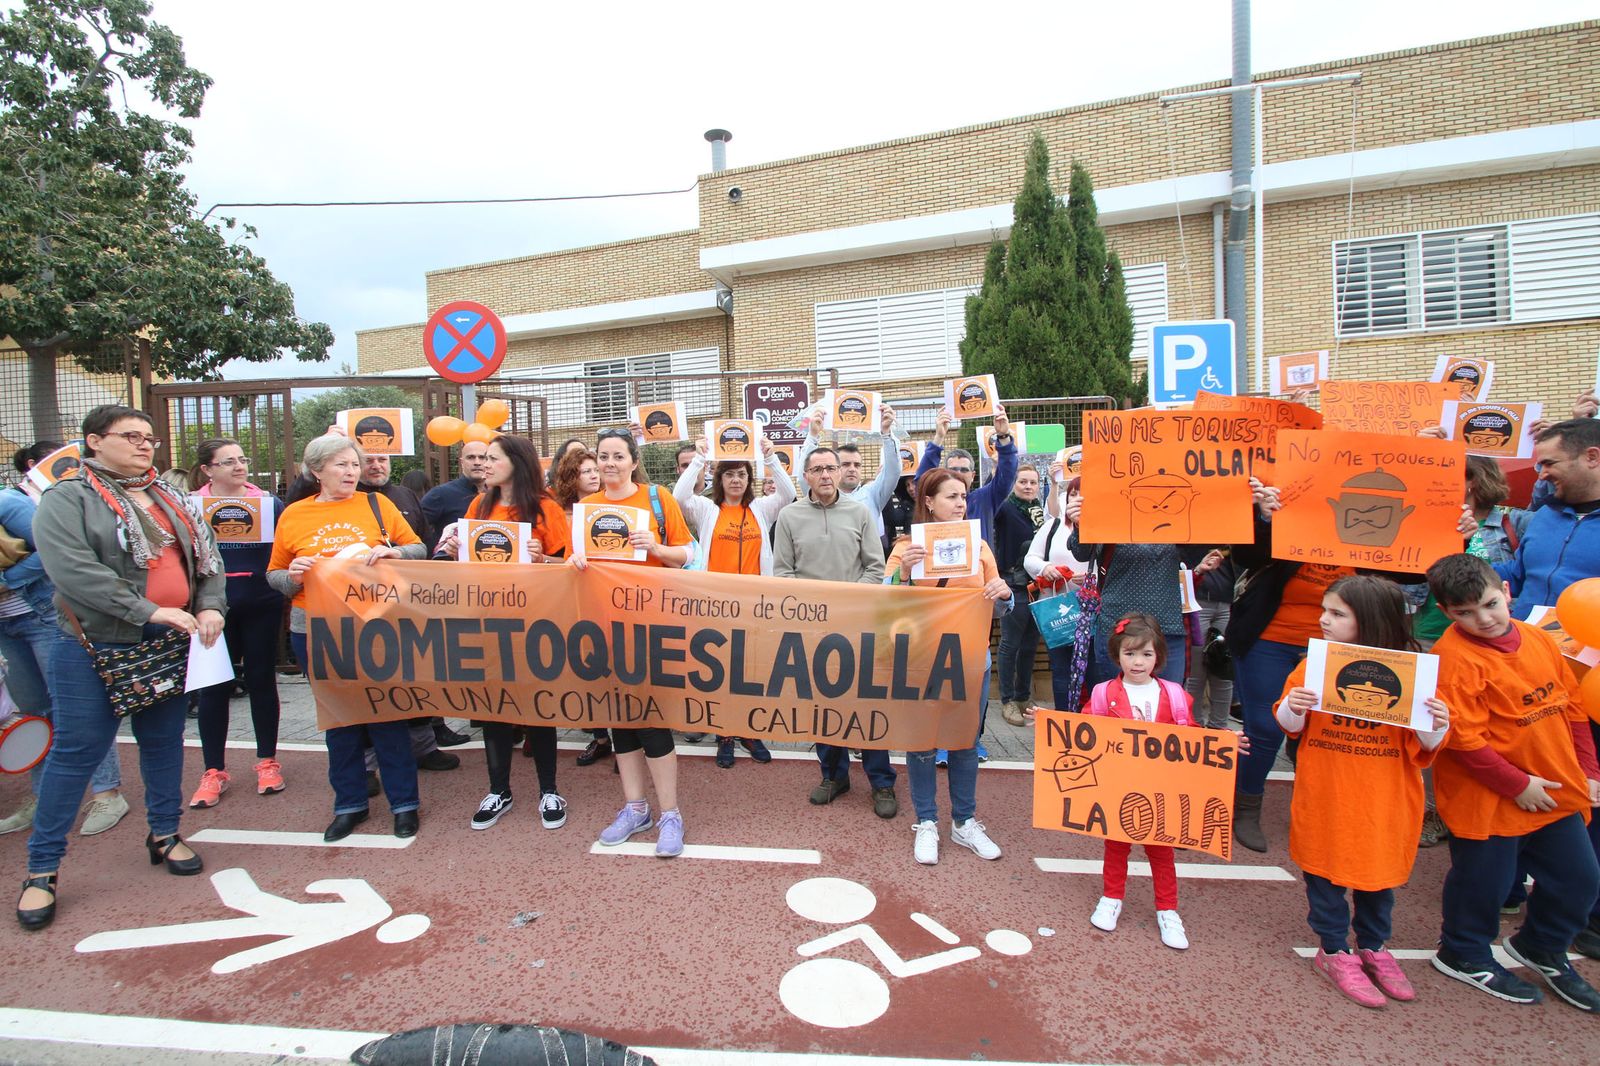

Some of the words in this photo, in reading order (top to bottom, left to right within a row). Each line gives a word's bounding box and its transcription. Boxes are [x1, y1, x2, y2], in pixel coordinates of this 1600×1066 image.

[1163, 335, 1207, 391] P
[1325, 381, 1432, 406] SUSANA
[772, 409, 802, 417] ALARM
[1353, 404, 1412, 420] HAGAS
[1131, 417, 1164, 444] ME
[1172, 416, 1261, 444] TOQUES
[1110, 452, 1145, 479] LA
[1334, 450, 1363, 466] ME
[309, 522, 367, 547] LACTANCIA
[323, 535, 355, 544] 100%
[345, 583, 401, 604] AMPA
[410, 583, 460, 606] Rafael
[468, 584, 527, 608] Florido
[661, 588, 740, 619] Francisco
[753, 594, 774, 620] de
[781, 596, 828, 622] Goya
[1050, 617, 1069, 627] Little
[365, 686, 439, 714] POR
[442, 687, 522, 716] UNA
[685, 697, 724, 729] DE
[1325, 703, 1409, 724] #nometoqueslaolla
[1047, 718, 1097, 751] NO
[1106, 740, 1124, 754] ME
[1122, 728, 1233, 770] TOQUES
[1308, 738, 1352, 754] COMEDORES
[1355, 745, 1400, 758] ESCOLARES
[1380, 735, 1389, 744] DE
[1062, 797, 1108, 835] LA
[1119, 792, 1230, 858] OLLA
